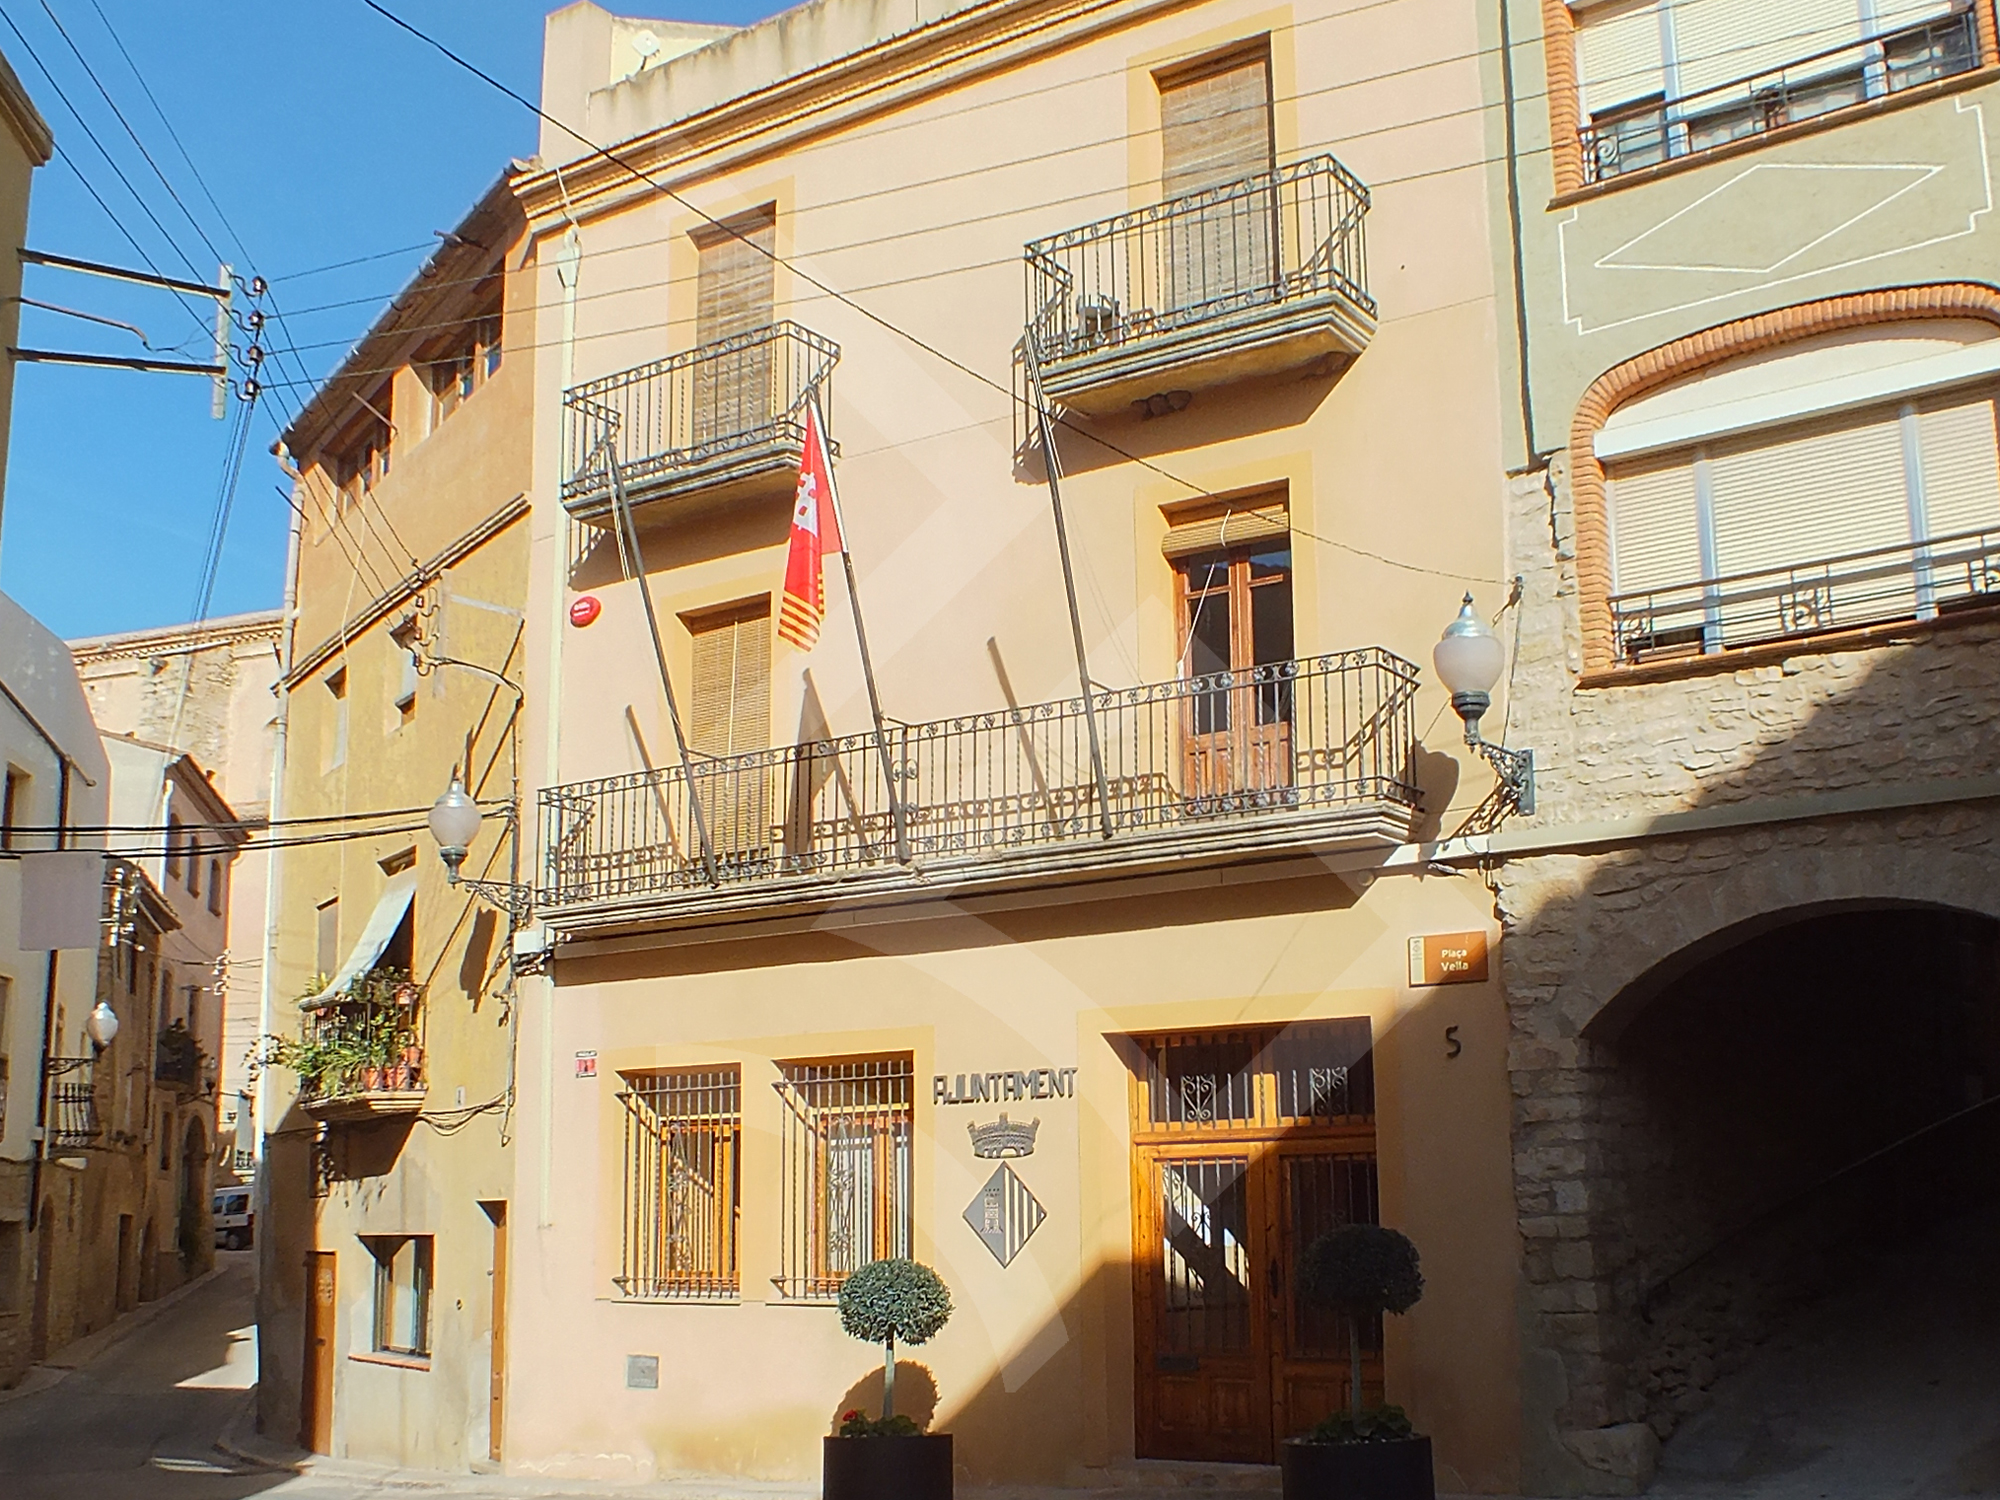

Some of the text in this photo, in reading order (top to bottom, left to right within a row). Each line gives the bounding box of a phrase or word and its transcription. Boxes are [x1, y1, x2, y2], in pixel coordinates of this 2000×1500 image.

[1441, 949, 1467, 959] Plaça
[1441, 961, 1469, 971] Vella
[1446, 1025, 1462, 1059] 5
[933, 1067, 1078, 1105] AJUNTAMENT
